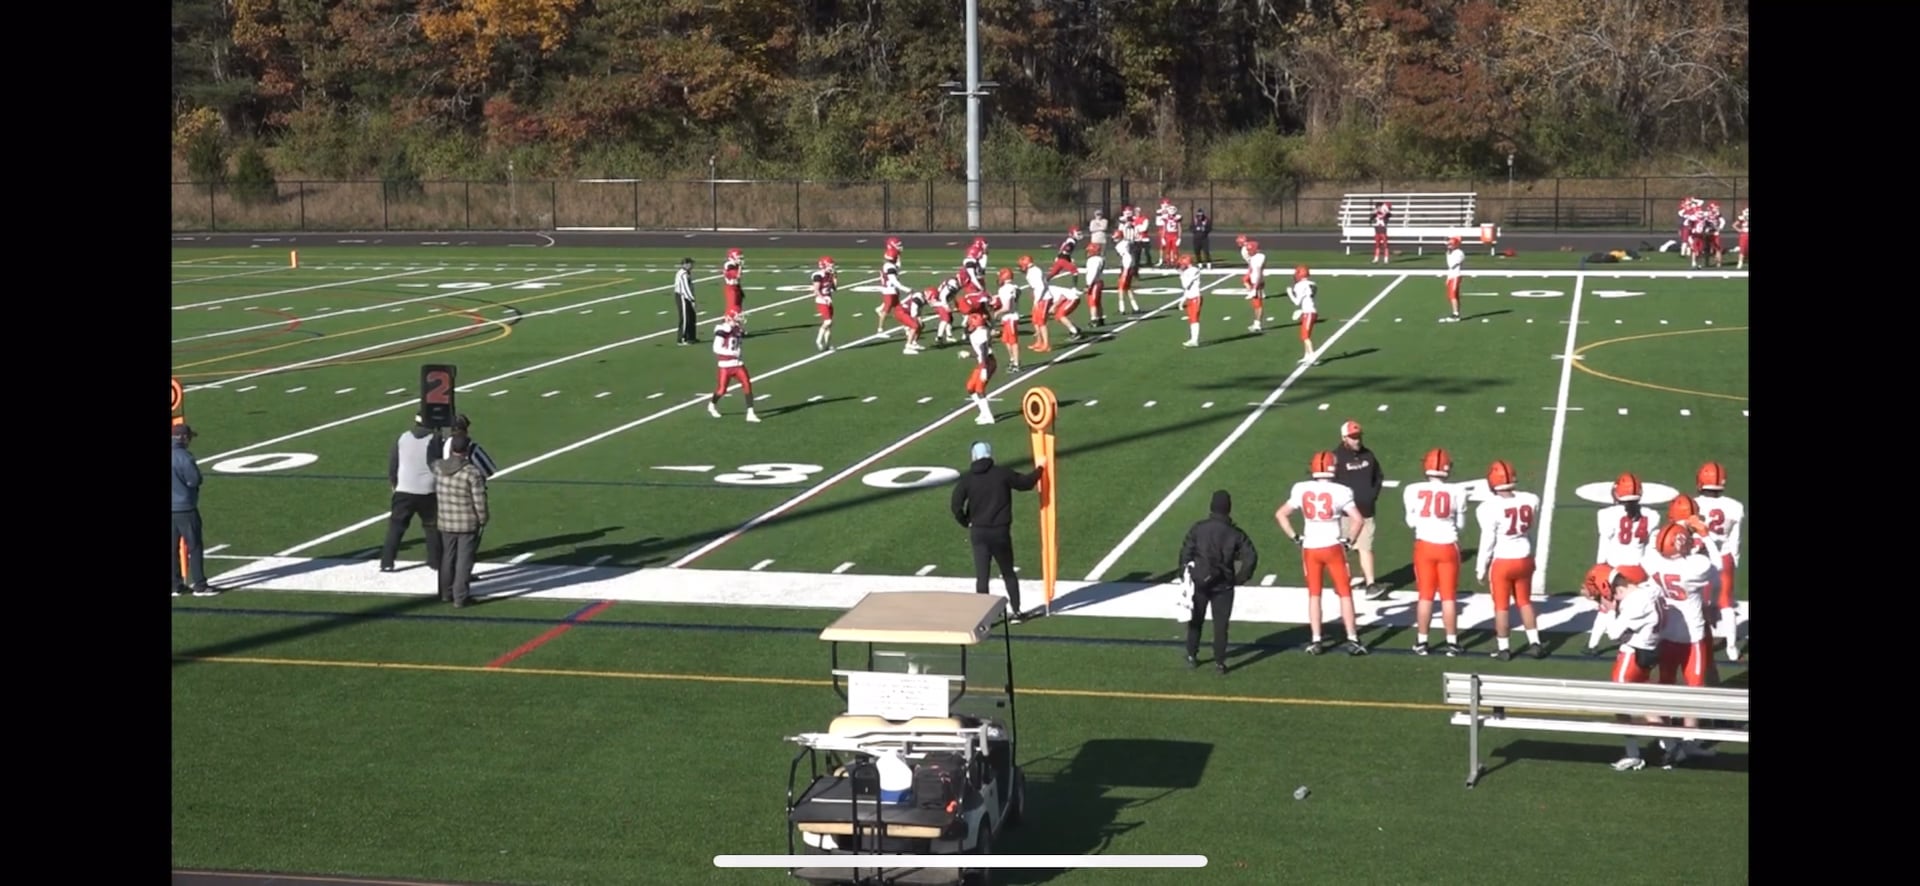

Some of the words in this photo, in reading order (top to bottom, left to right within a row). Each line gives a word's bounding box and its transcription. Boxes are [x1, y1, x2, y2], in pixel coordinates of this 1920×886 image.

[426, 370, 450, 404] 2
[1302, 490, 1334, 520] 63
[1418, 490, 1451, 519] 70
[1504, 504, 1533, 536] 79
[1618, 515, 1649, 545] 84
